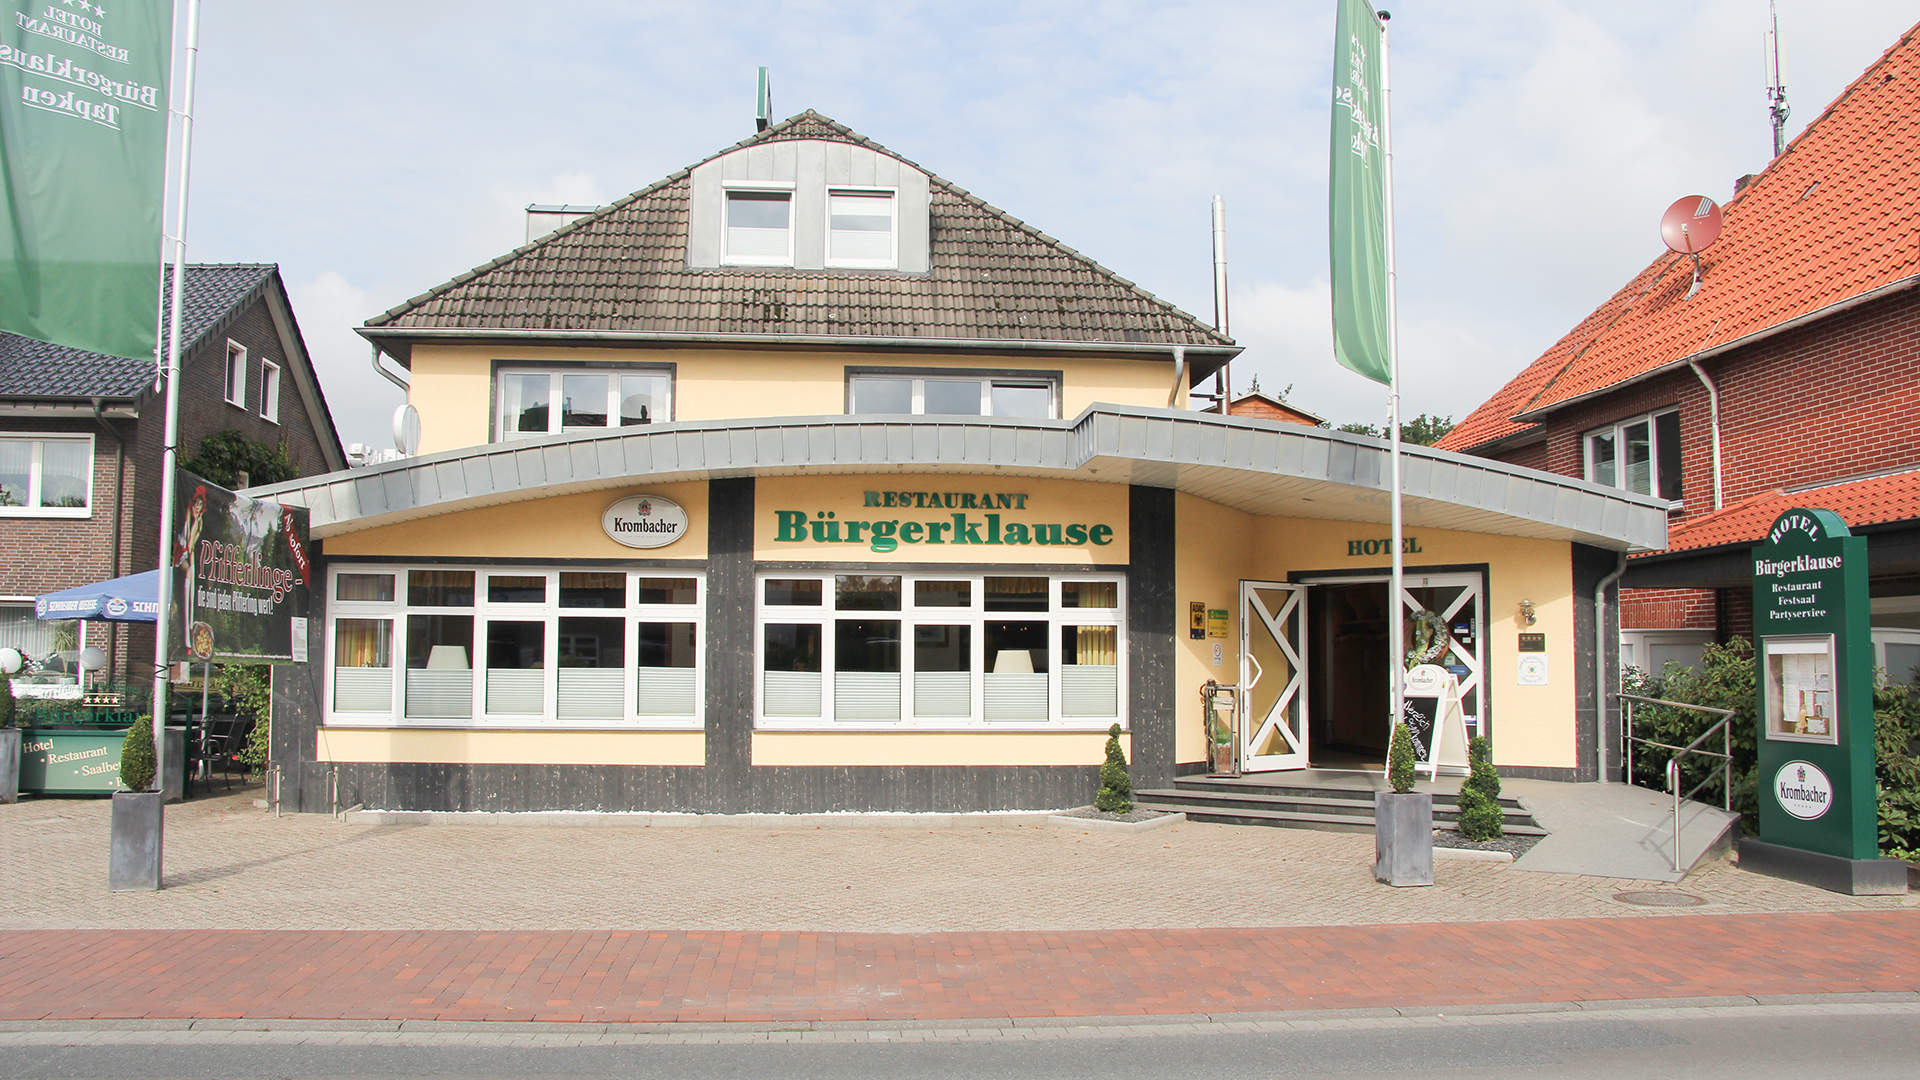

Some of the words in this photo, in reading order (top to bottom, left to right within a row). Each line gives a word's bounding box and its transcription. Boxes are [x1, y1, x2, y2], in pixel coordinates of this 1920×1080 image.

[863, 491, 1029, 509] RESTAURANT
[614, 517, 678, 533] Krombacher
[774, 510, 1113, 553] Bürgerklause
[1770, 514, 1819, 545] HOTEL
[289, 533, 306, 570] sofort
[1347, 538, 1423, 556] HOTEL
[198, 539, 294, 603] Pfifferlinge
[1755, 555, 1842, 578] Bürgerklause
[1772, 580, 1822, 593] Restaurant
[132, 602, 159, 613] SCHN
[217, 588, 231, 612] jeden
[1778, 594, 1816, 605] Festsaal
[1769, 608, 1827, 620] Partyservice
[36, 708, 146, 726] Bürgerklau
[23, 739, 54, 753] Hotel
[48, 746, 108, 764] Restaurant
[1780, 781, 1827, 803] Krombacher
